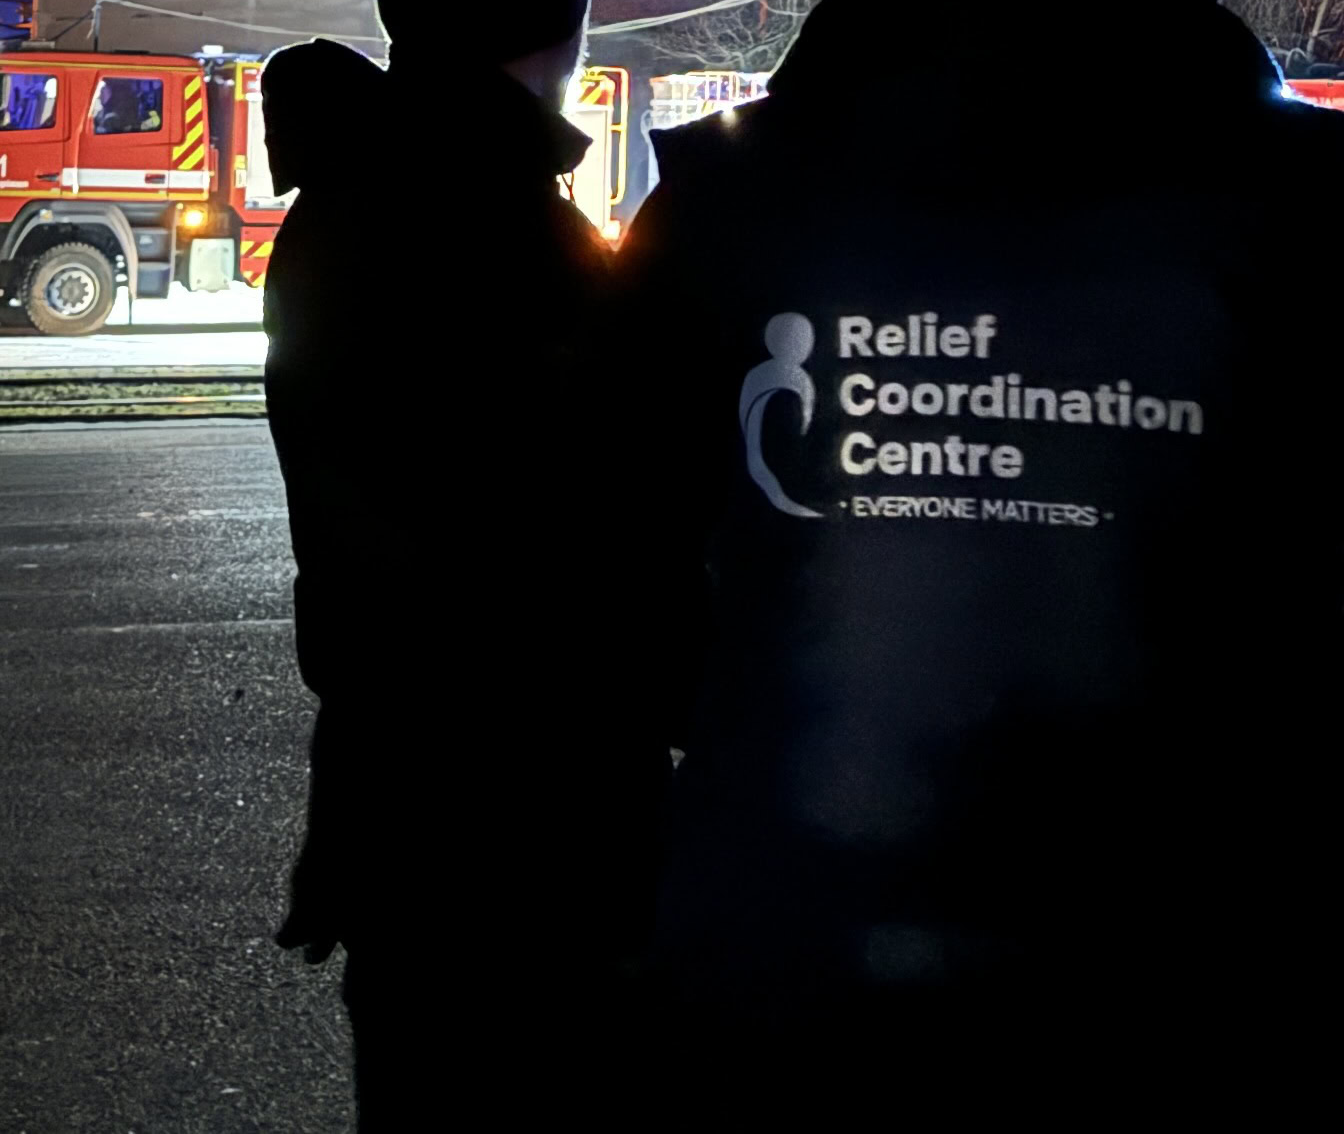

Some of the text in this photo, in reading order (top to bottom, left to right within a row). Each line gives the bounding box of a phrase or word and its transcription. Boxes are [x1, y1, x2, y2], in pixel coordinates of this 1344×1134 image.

[839, 311, 998, 359] Relief
[839, 372, 1204, 435] Coordination
[840, 431, 1024, 479] Centre
[854, 495, 1100, 527] EVERYONE MATTERS
